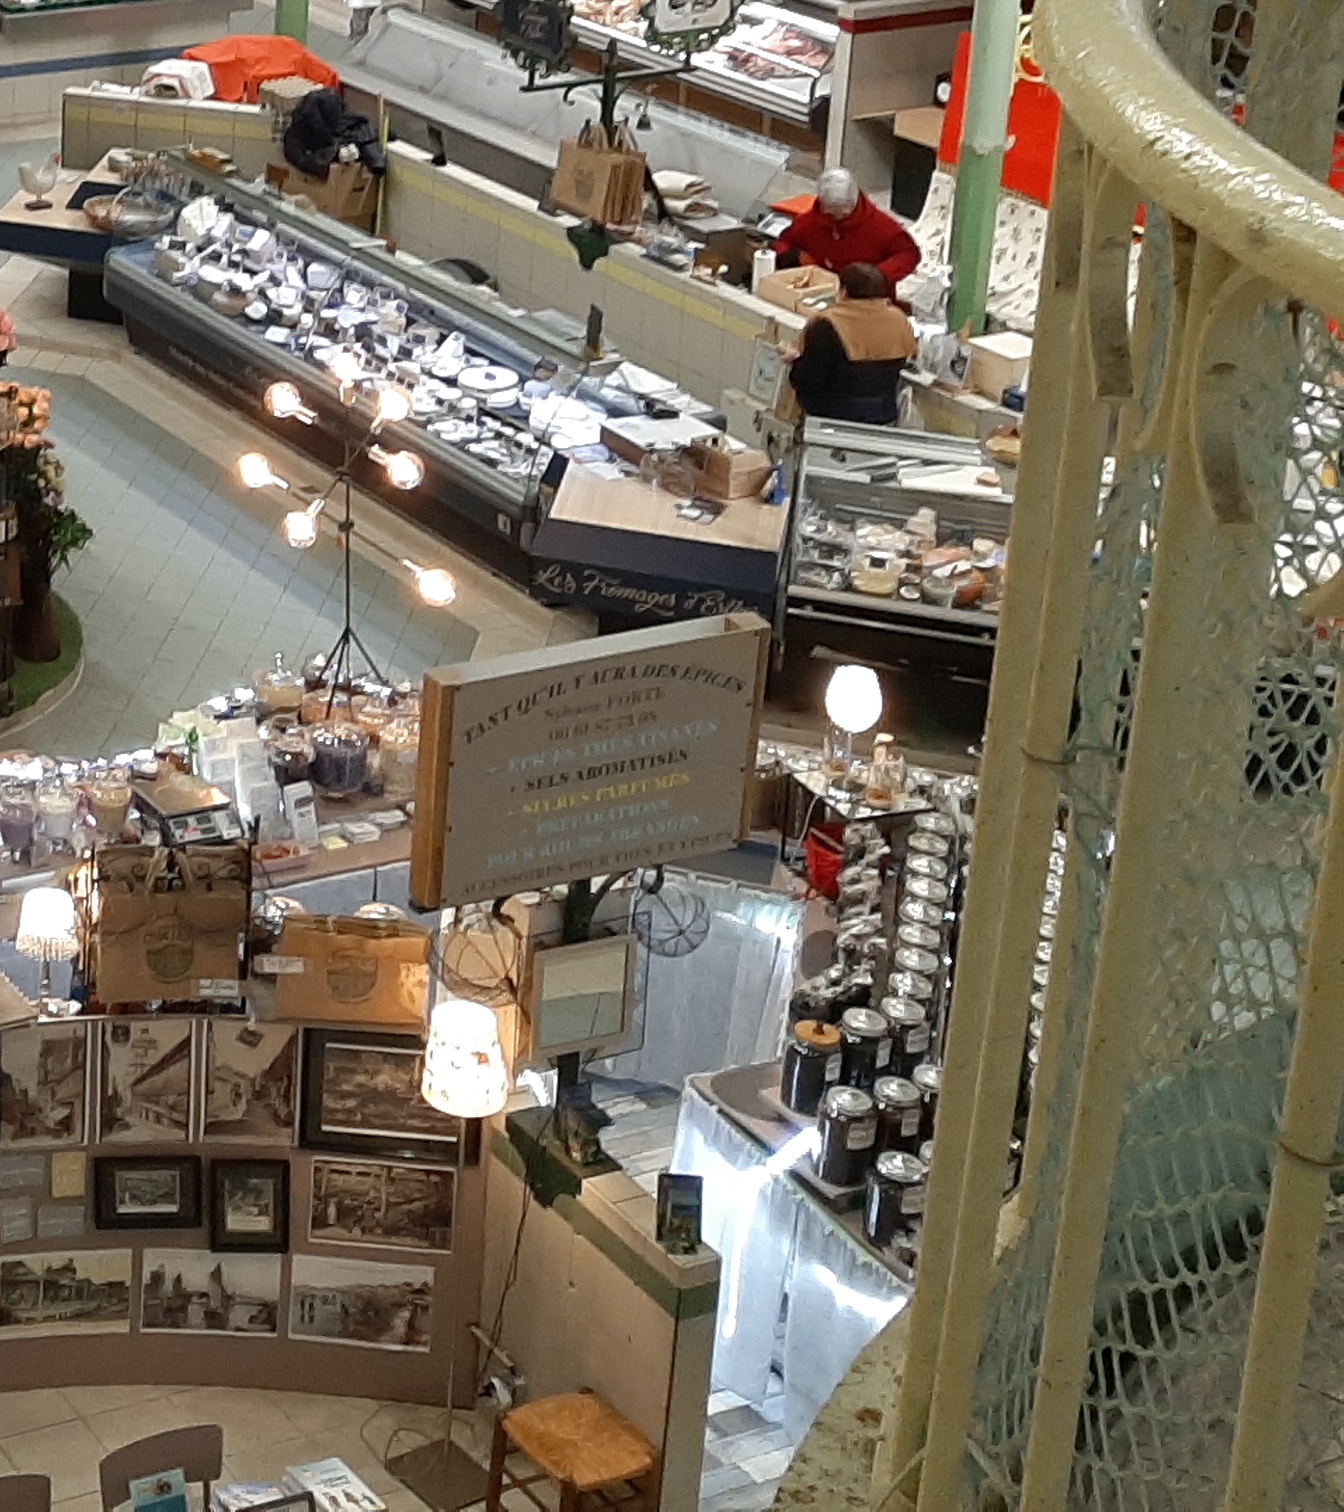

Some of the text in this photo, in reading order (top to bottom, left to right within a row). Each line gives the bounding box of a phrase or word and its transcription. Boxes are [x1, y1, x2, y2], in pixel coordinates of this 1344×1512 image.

[533, 564, 577, 595] Les
[583, 569, 677, 618] Fromages
[462, 703, 513, 745] TANT
[588, 665, 639, 686] AURA
[640, 664, 678, 680] DES
[524, 771, 569, 792] SELS
